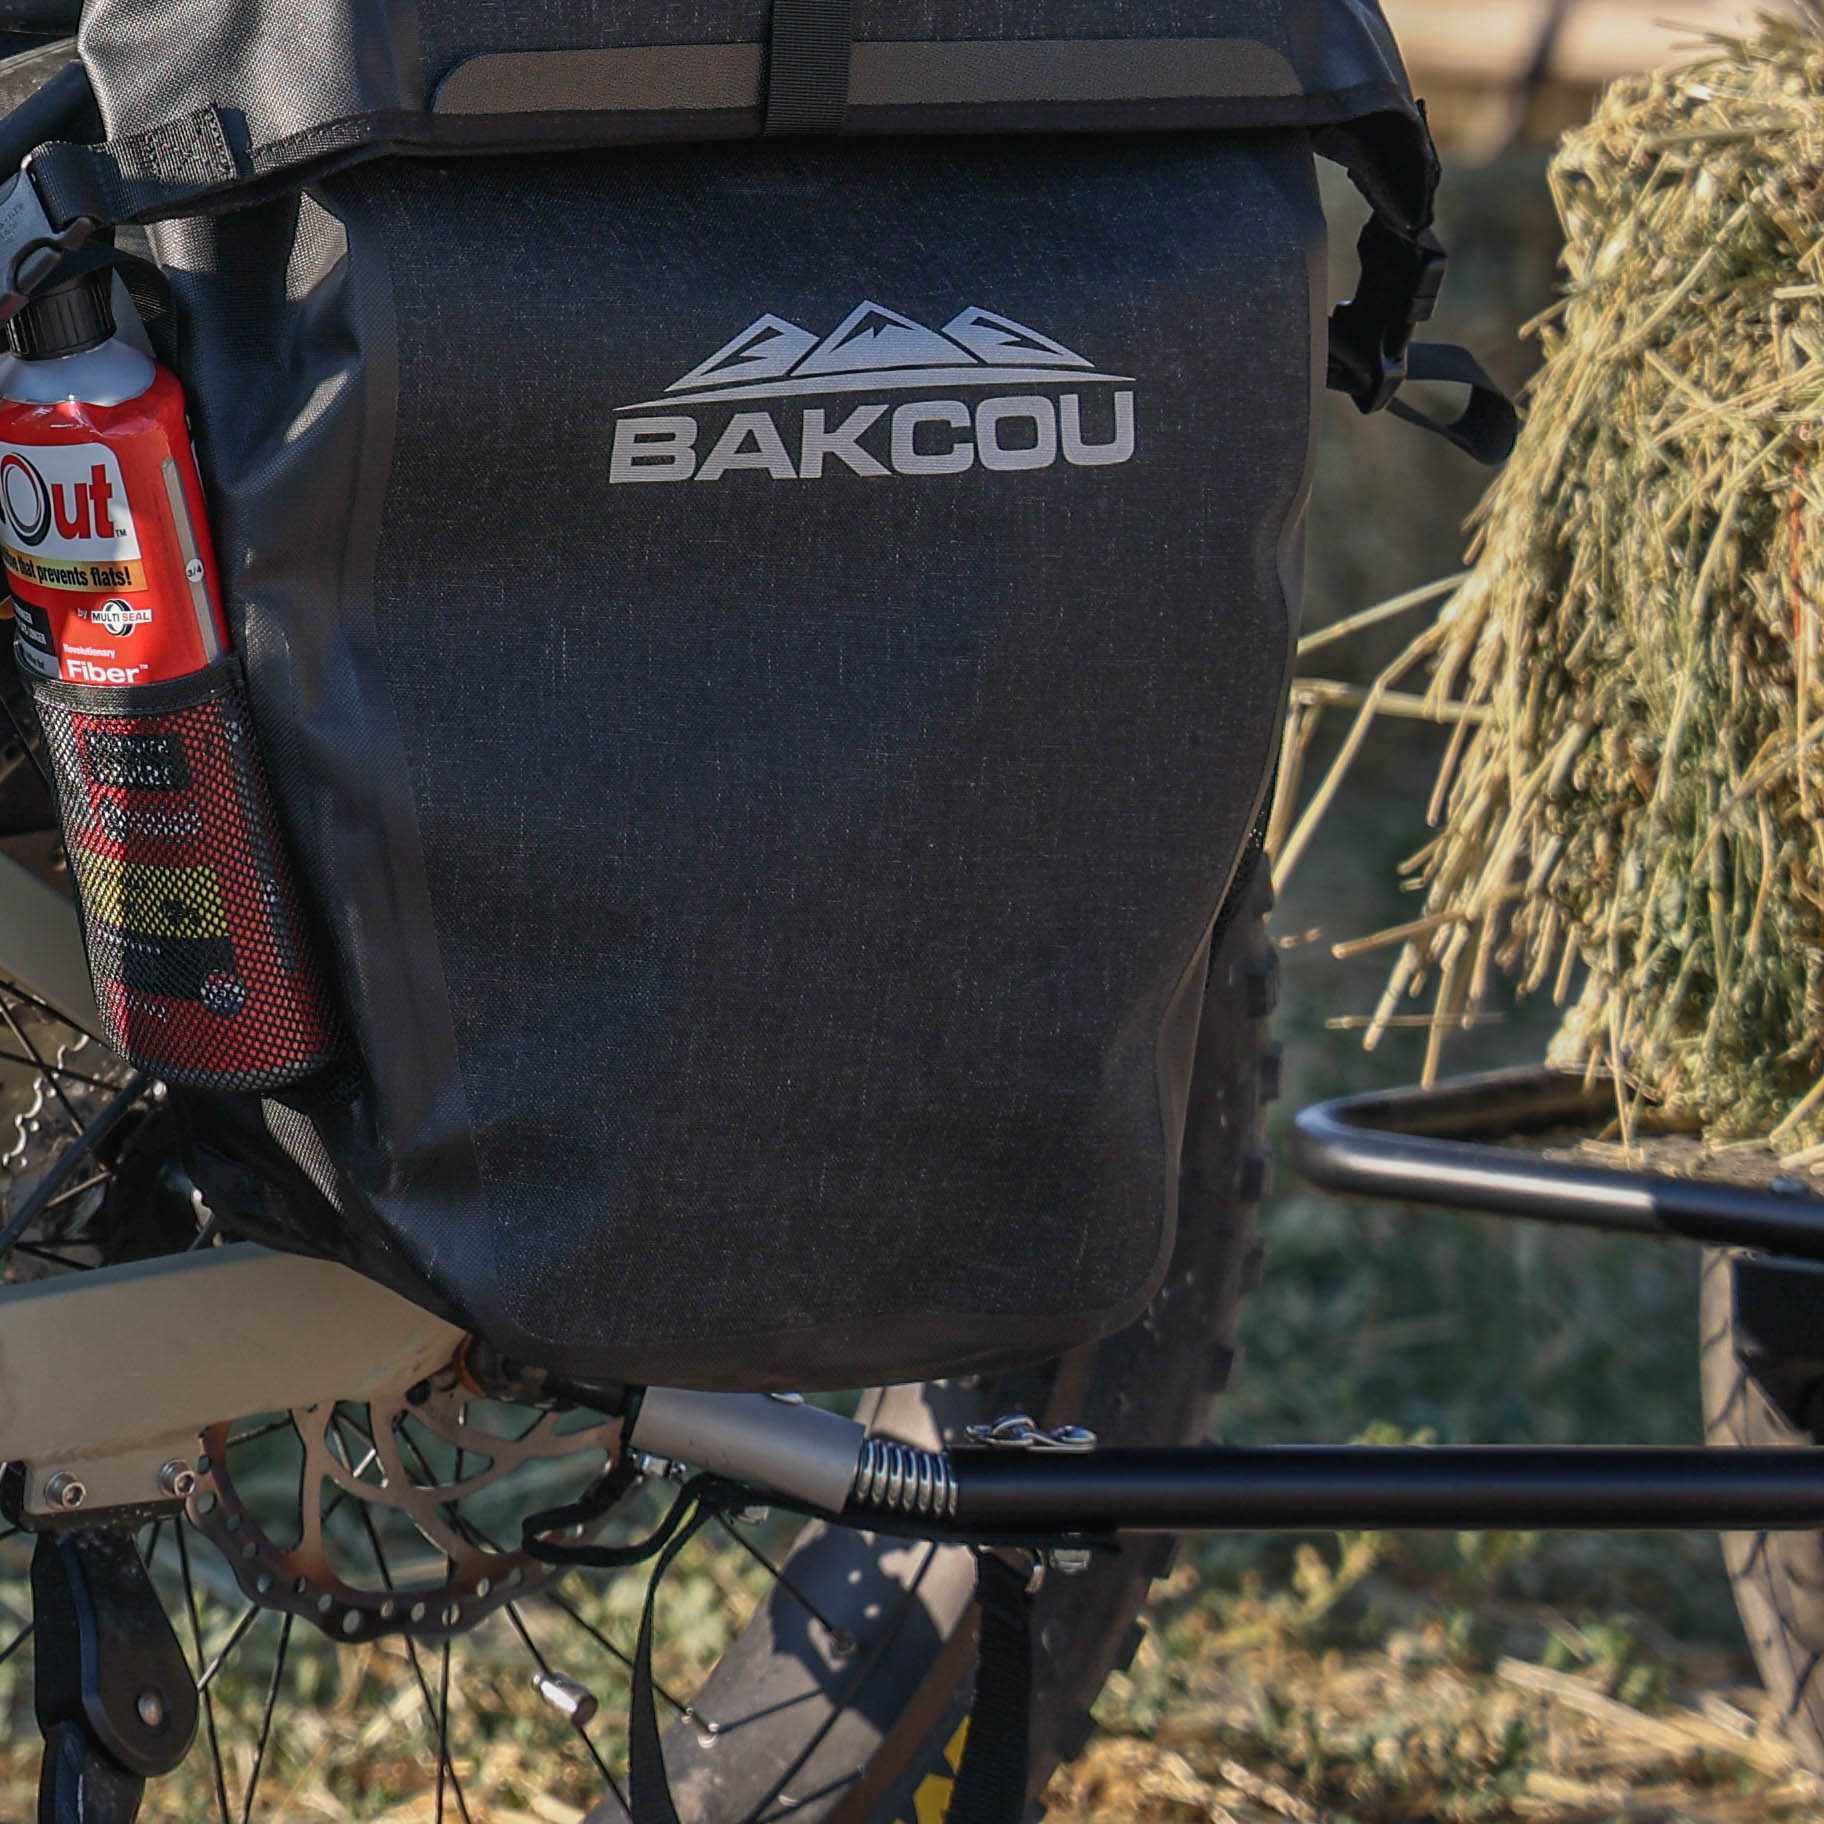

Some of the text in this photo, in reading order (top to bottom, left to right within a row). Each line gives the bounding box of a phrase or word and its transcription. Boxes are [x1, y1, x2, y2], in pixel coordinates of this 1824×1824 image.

[609, 389, 1137, 484] BAKCOU
[36, 565, 89, 585] prevents
[91, 566, 133, 587] flats!
[92, 612, 121, 623] MULTI
[121, 610, 150, 622] SEAL
[66, 659, 141, 683] Fiber
